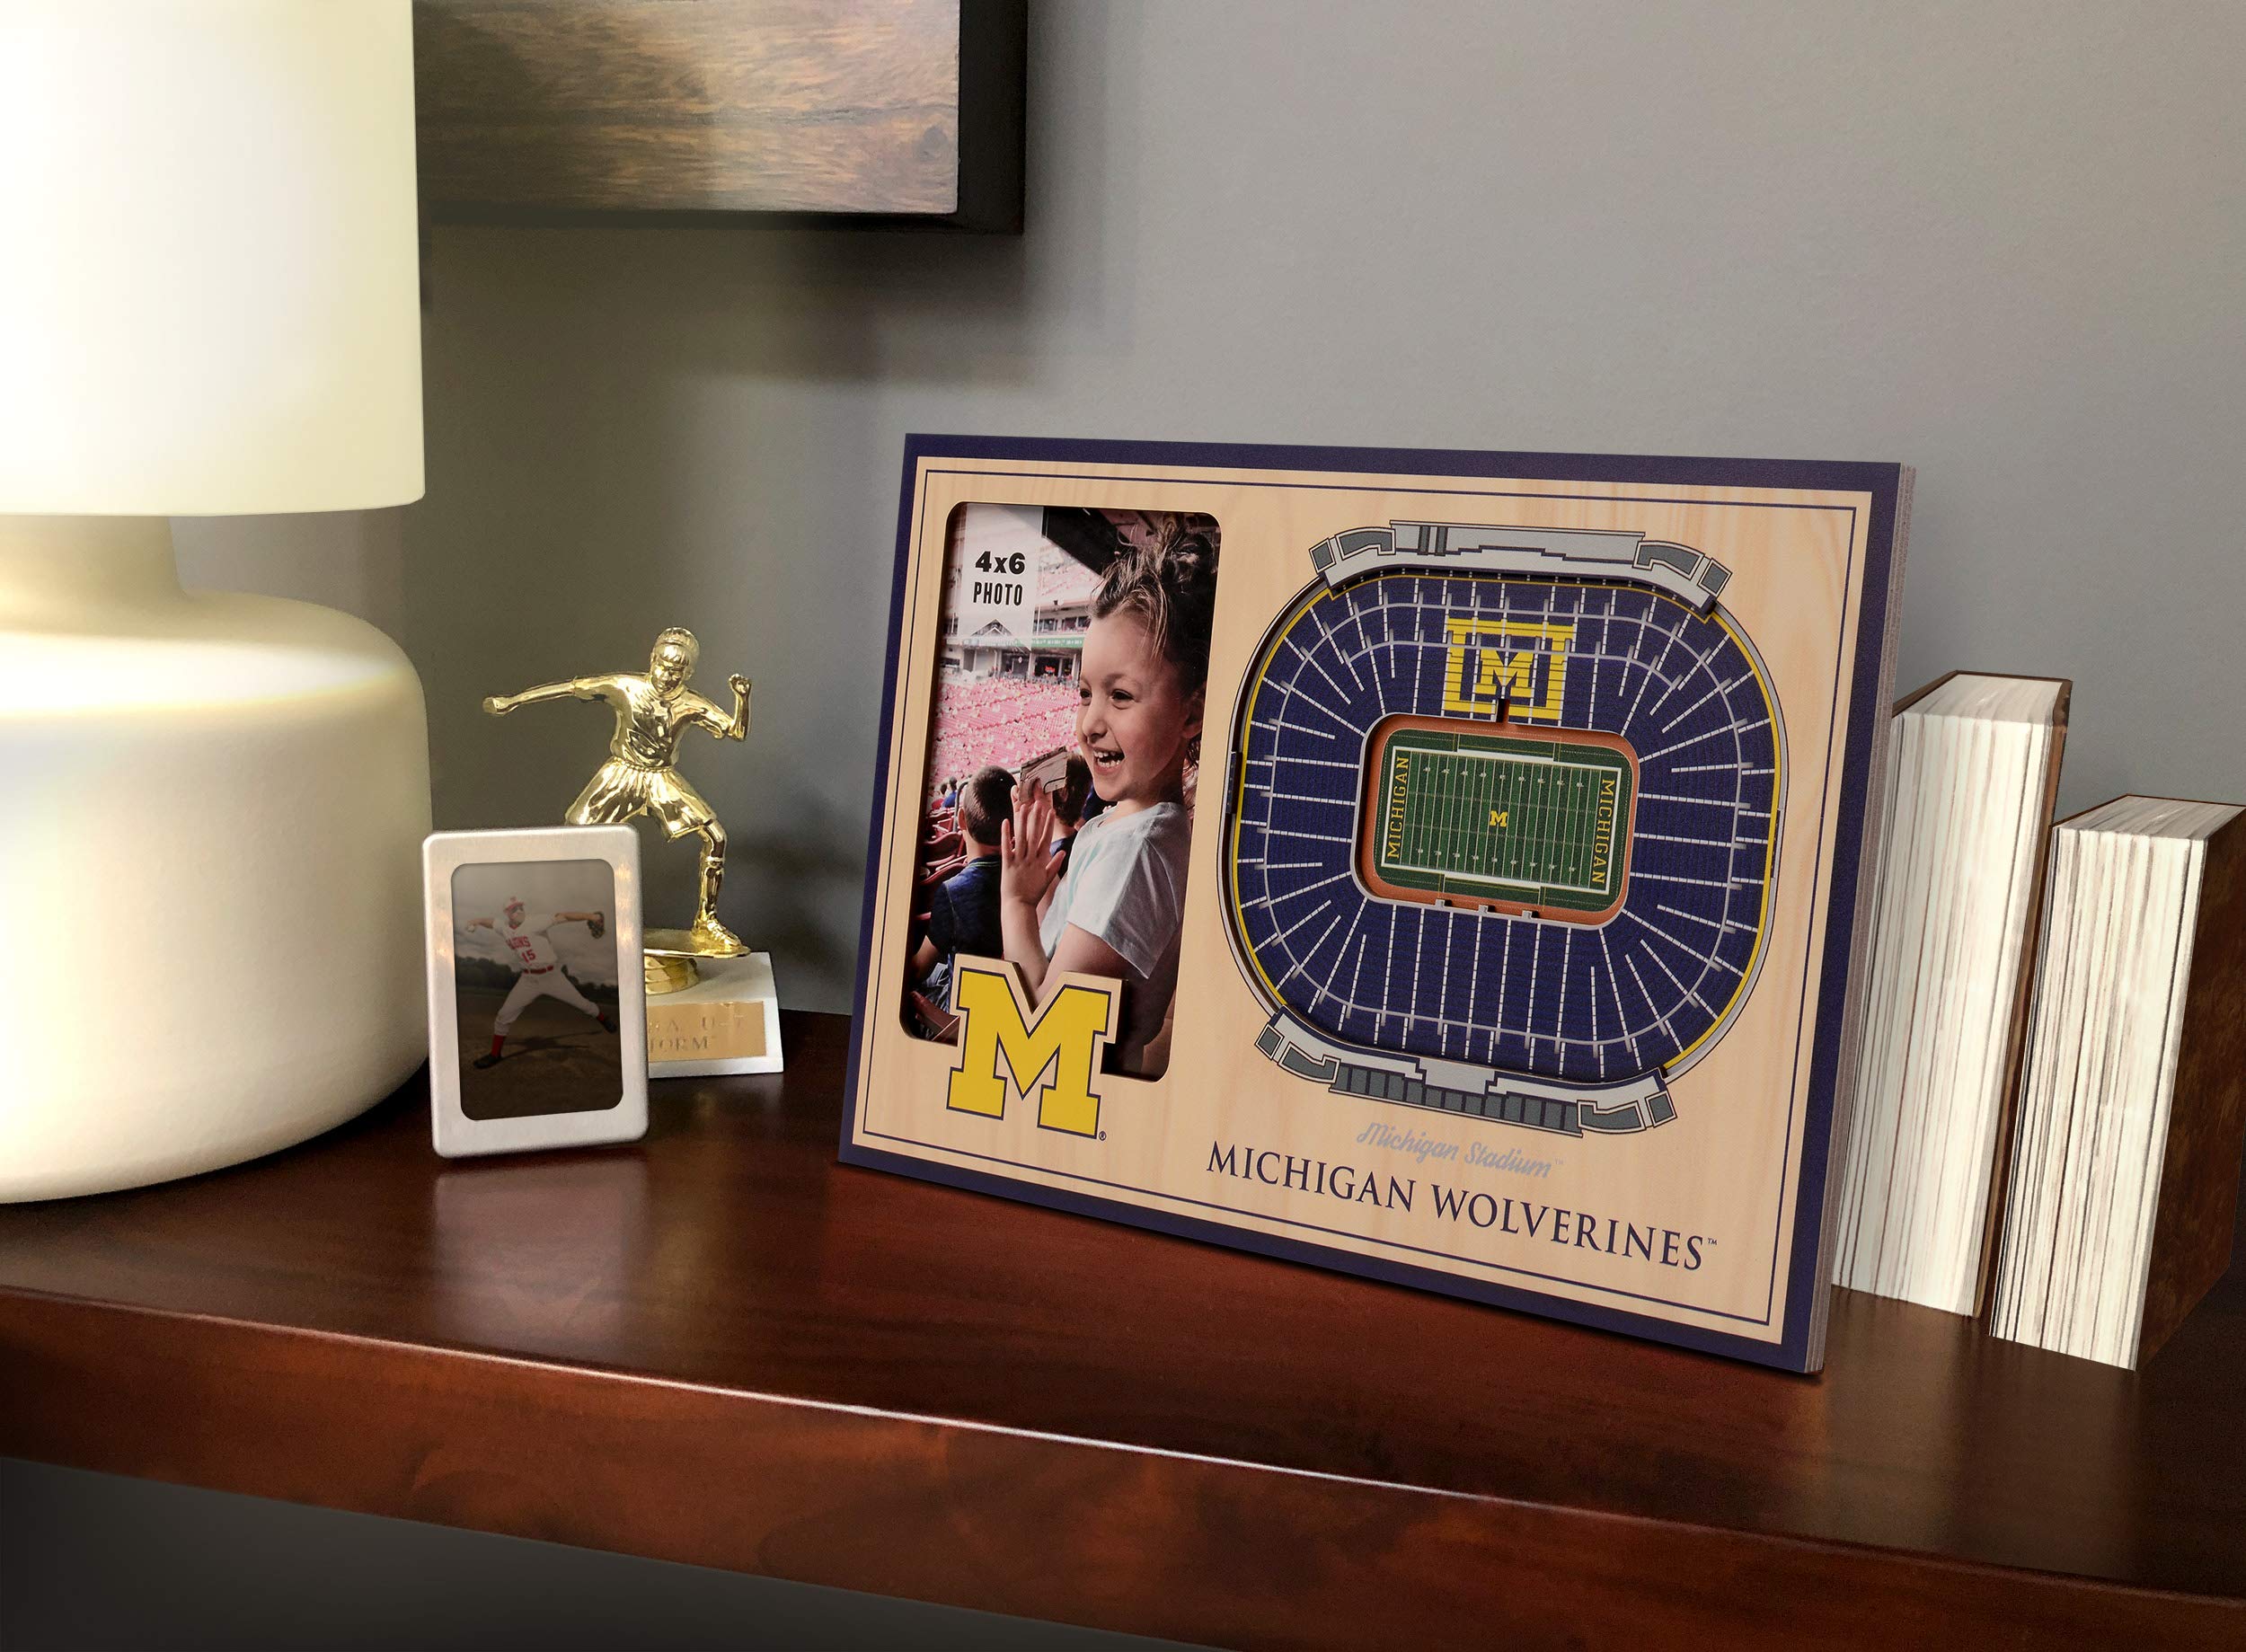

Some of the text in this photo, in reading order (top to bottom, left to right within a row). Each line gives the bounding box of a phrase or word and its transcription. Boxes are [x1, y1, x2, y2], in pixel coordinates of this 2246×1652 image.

[975, 551, 1026, 575] 4x6
[973, 581, 1023, 606] PHOTO
[1386, 756, 1410, 859] MICHIGAN
[1489, 809, 1508, 827] M
[1591, 778, 1615, 884] MICHIGAN
[521, 949, 536, 963] 15
[1357, 1122, 1459, 1164] Michigan
[1207, 1140, 1417, 1213] MICHIGAN
